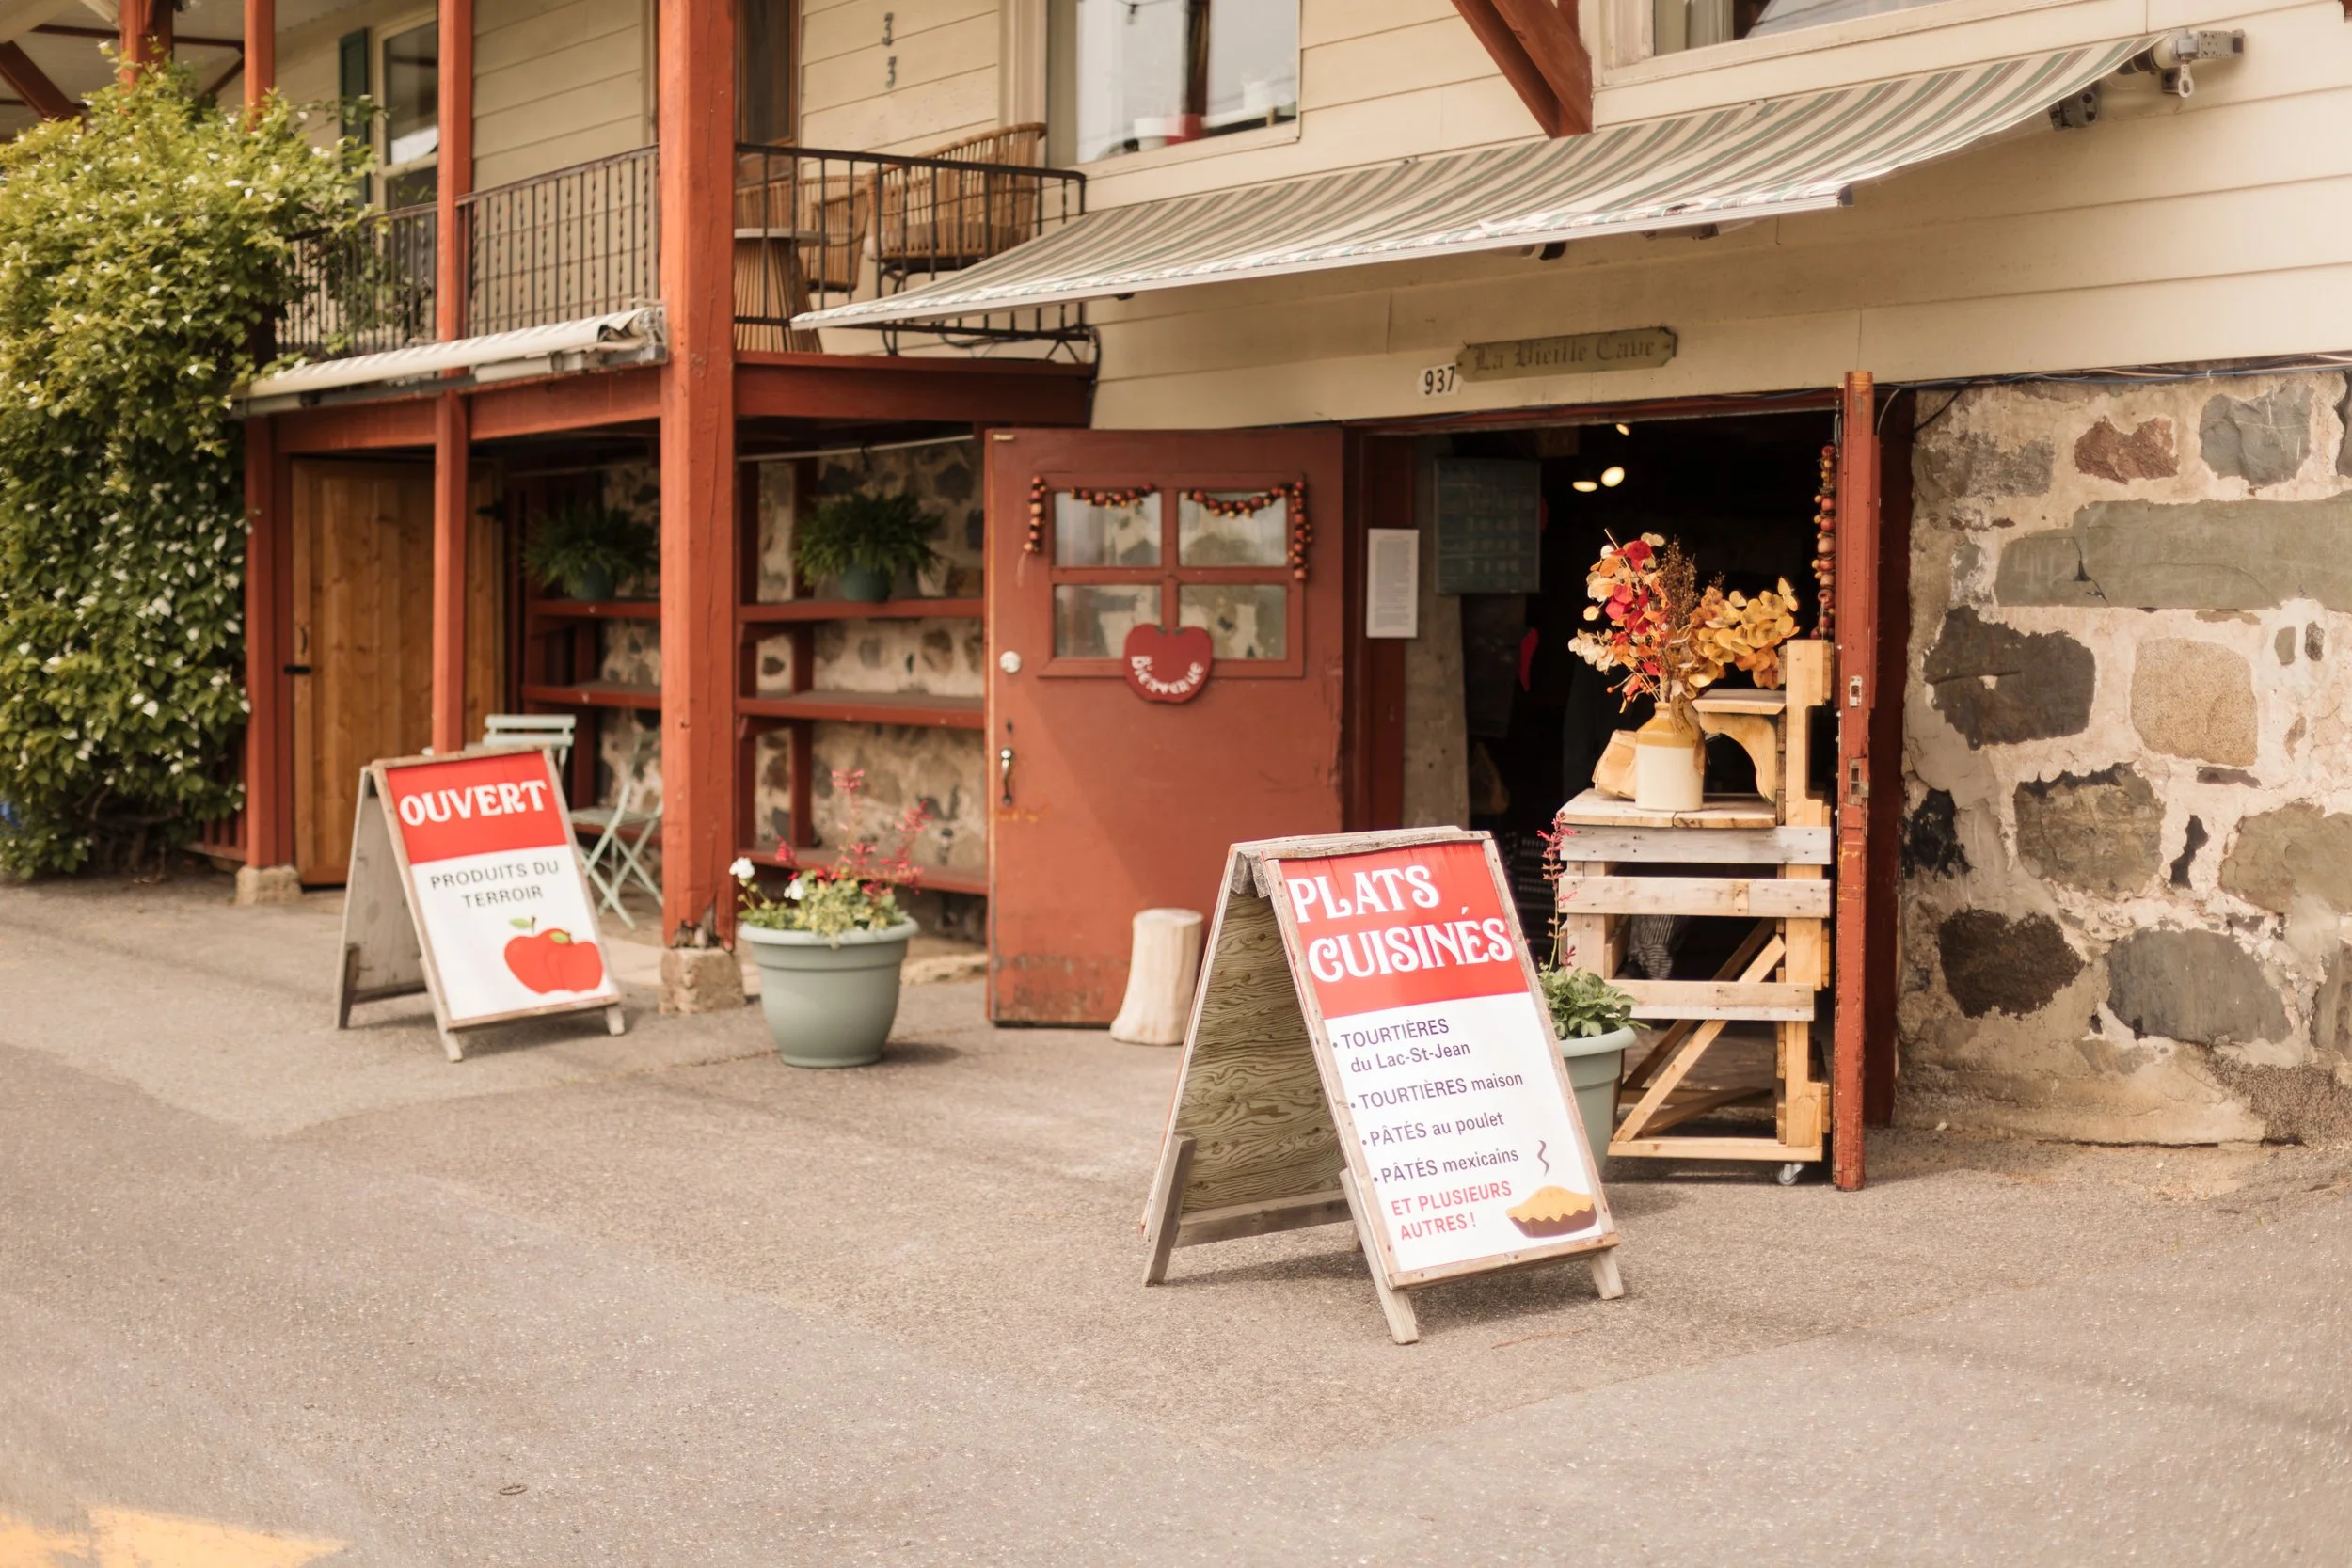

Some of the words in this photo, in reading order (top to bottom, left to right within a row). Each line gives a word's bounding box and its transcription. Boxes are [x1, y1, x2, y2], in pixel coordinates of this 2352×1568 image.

[1473, 342, 1503, 371] La
[1597, 336, 1655, 361] Cave
[1424, 365, 1455, 396] 937
[399, 780, 547, 826] OUVERT
[430, 863, 528, 889] PRODUITS
[533, 861, 559, 875] DU
[462, 885, 543, 909] TERROIR
[1286, 865, 1439, 923] PLATS
[1308, 907, 1514, 982] CUISINÉS
[1340, 1018, 1450, 1049] TOURTIÈRES
[1350, 1057, 1373, 1073] du
[1375, 1042, 1470, 1069] Lac-St-Jean
[1359, 1077, 1467, 1110] TOURTIÈRES
[1470, 1072, 1524, 1092] maison
[1370, 1121, 1427, 1147] PÂTÉS
[1432, 1122, 1452, 1135] au
[1455, 1111, 1504, 1135] poulet
[1380, 1158, 1438, 1184] PÂTÉS
[1442, 1148, 1518, 1173] mexicains
[1391, 1197, 1412, 1217] ET
[1418, 1180, 1512, 1212] PLUSIEURS
